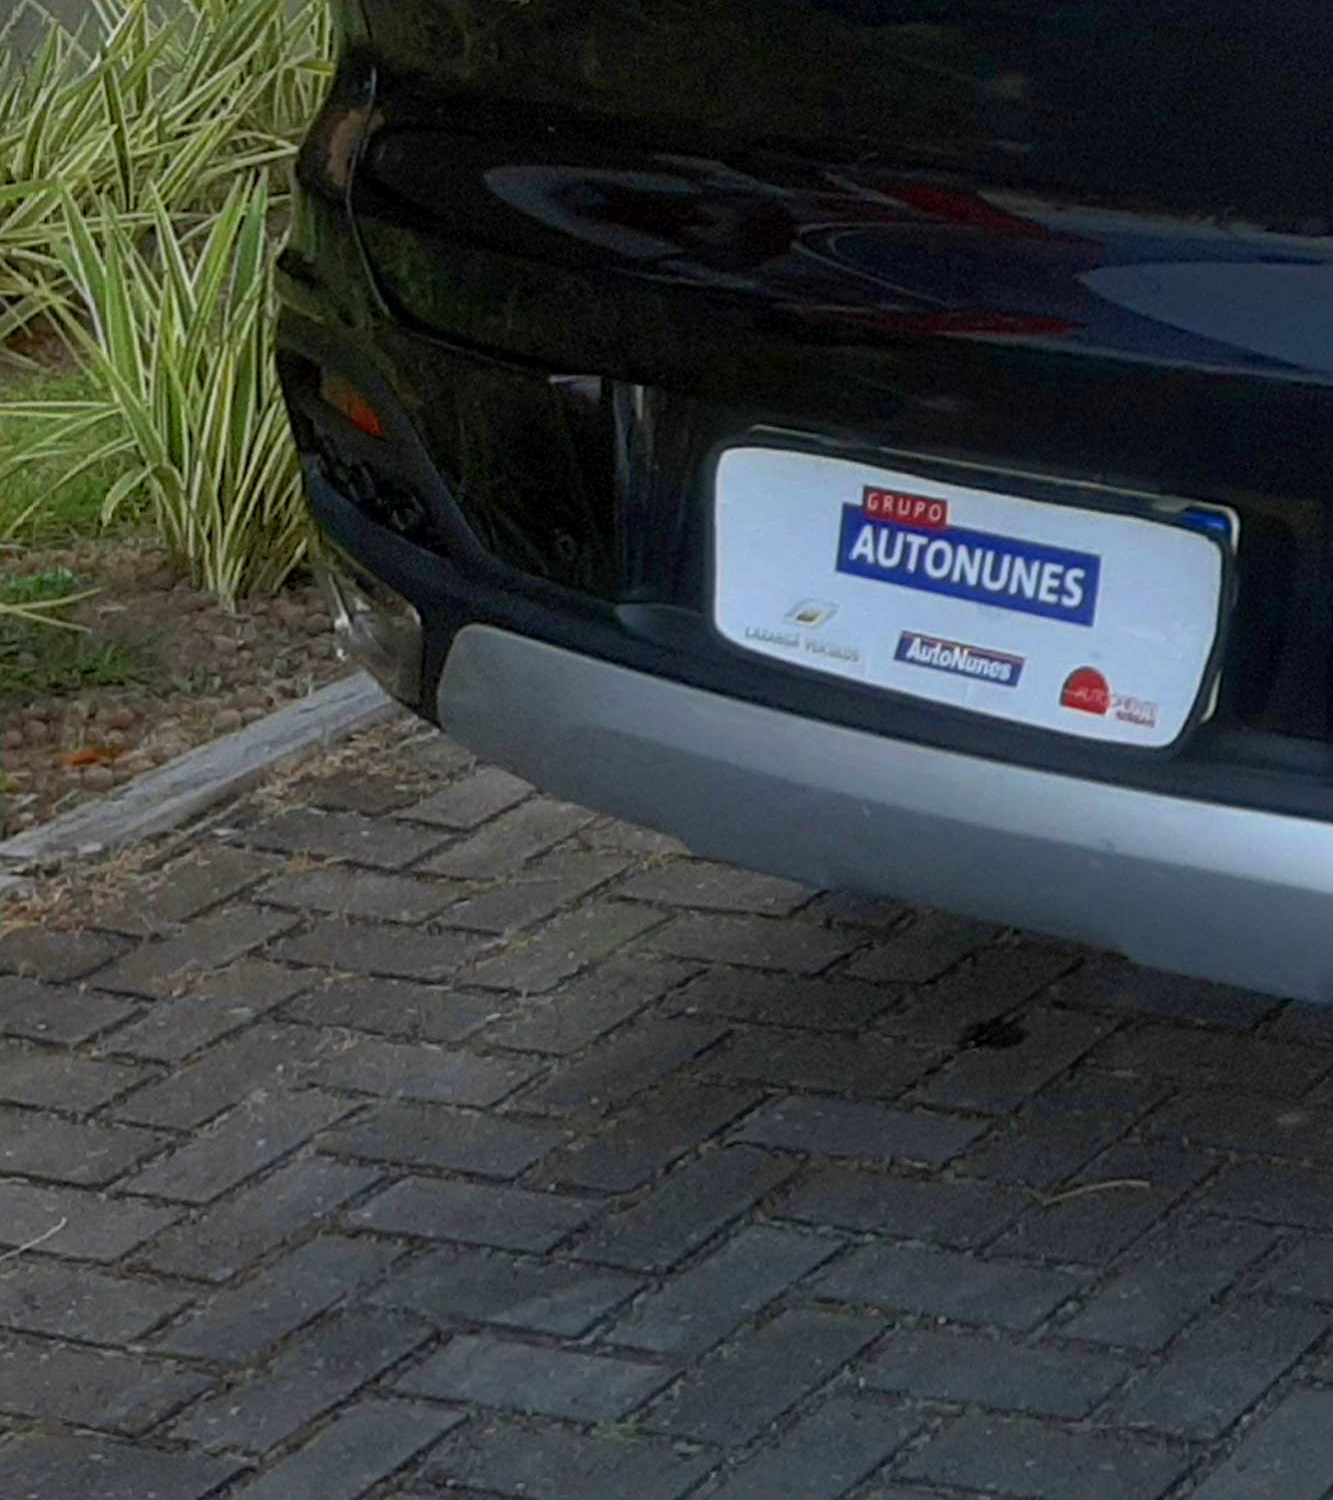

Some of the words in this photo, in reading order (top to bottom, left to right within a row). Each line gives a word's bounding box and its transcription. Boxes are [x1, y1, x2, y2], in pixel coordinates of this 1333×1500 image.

[866, 491, 944, 522] GRUPO
[848, 523, 1087, 608] AUTONUNES
[905, 636, 1013, 681] AutoNunes
